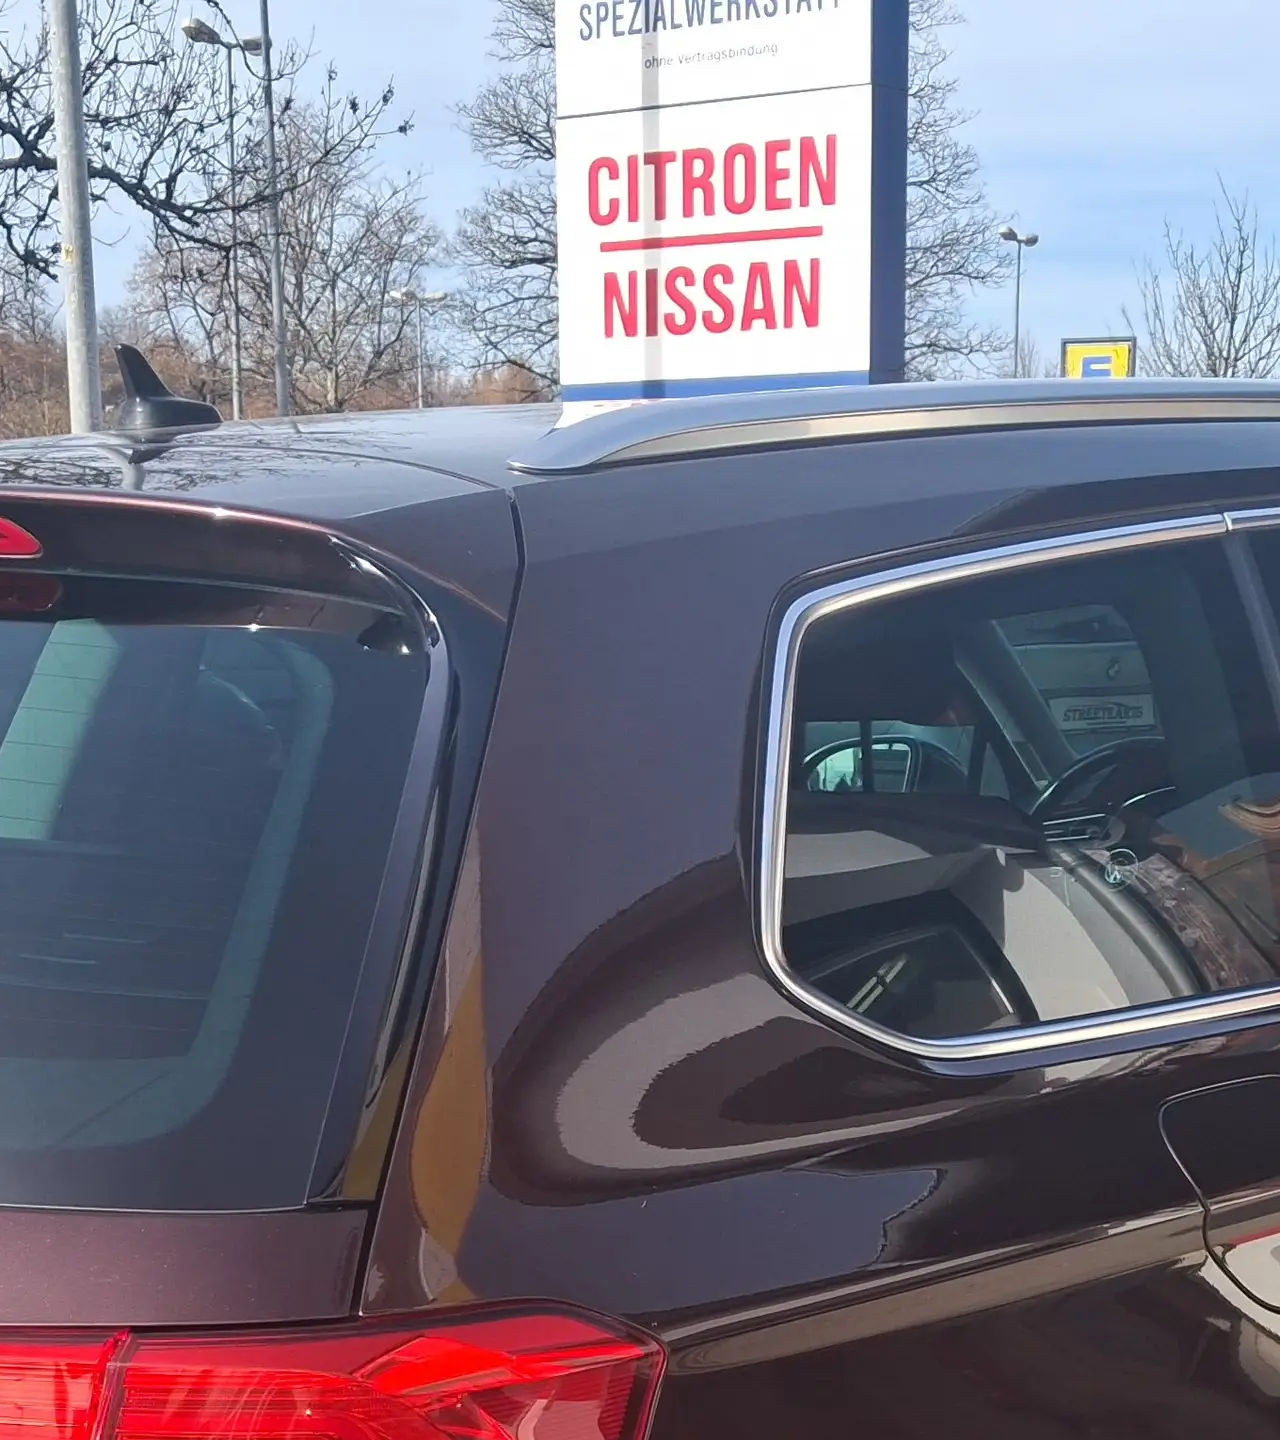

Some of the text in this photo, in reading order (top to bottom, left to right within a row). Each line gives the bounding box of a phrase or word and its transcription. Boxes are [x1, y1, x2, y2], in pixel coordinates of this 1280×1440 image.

[579, 0, 839, 41] SPEZIALWERK
[644, 42, 778, 69] ohne Vertragsbindung
[588, 134, 837, 226] CITROEN
[604, 258, 820, 338] NISSAN
